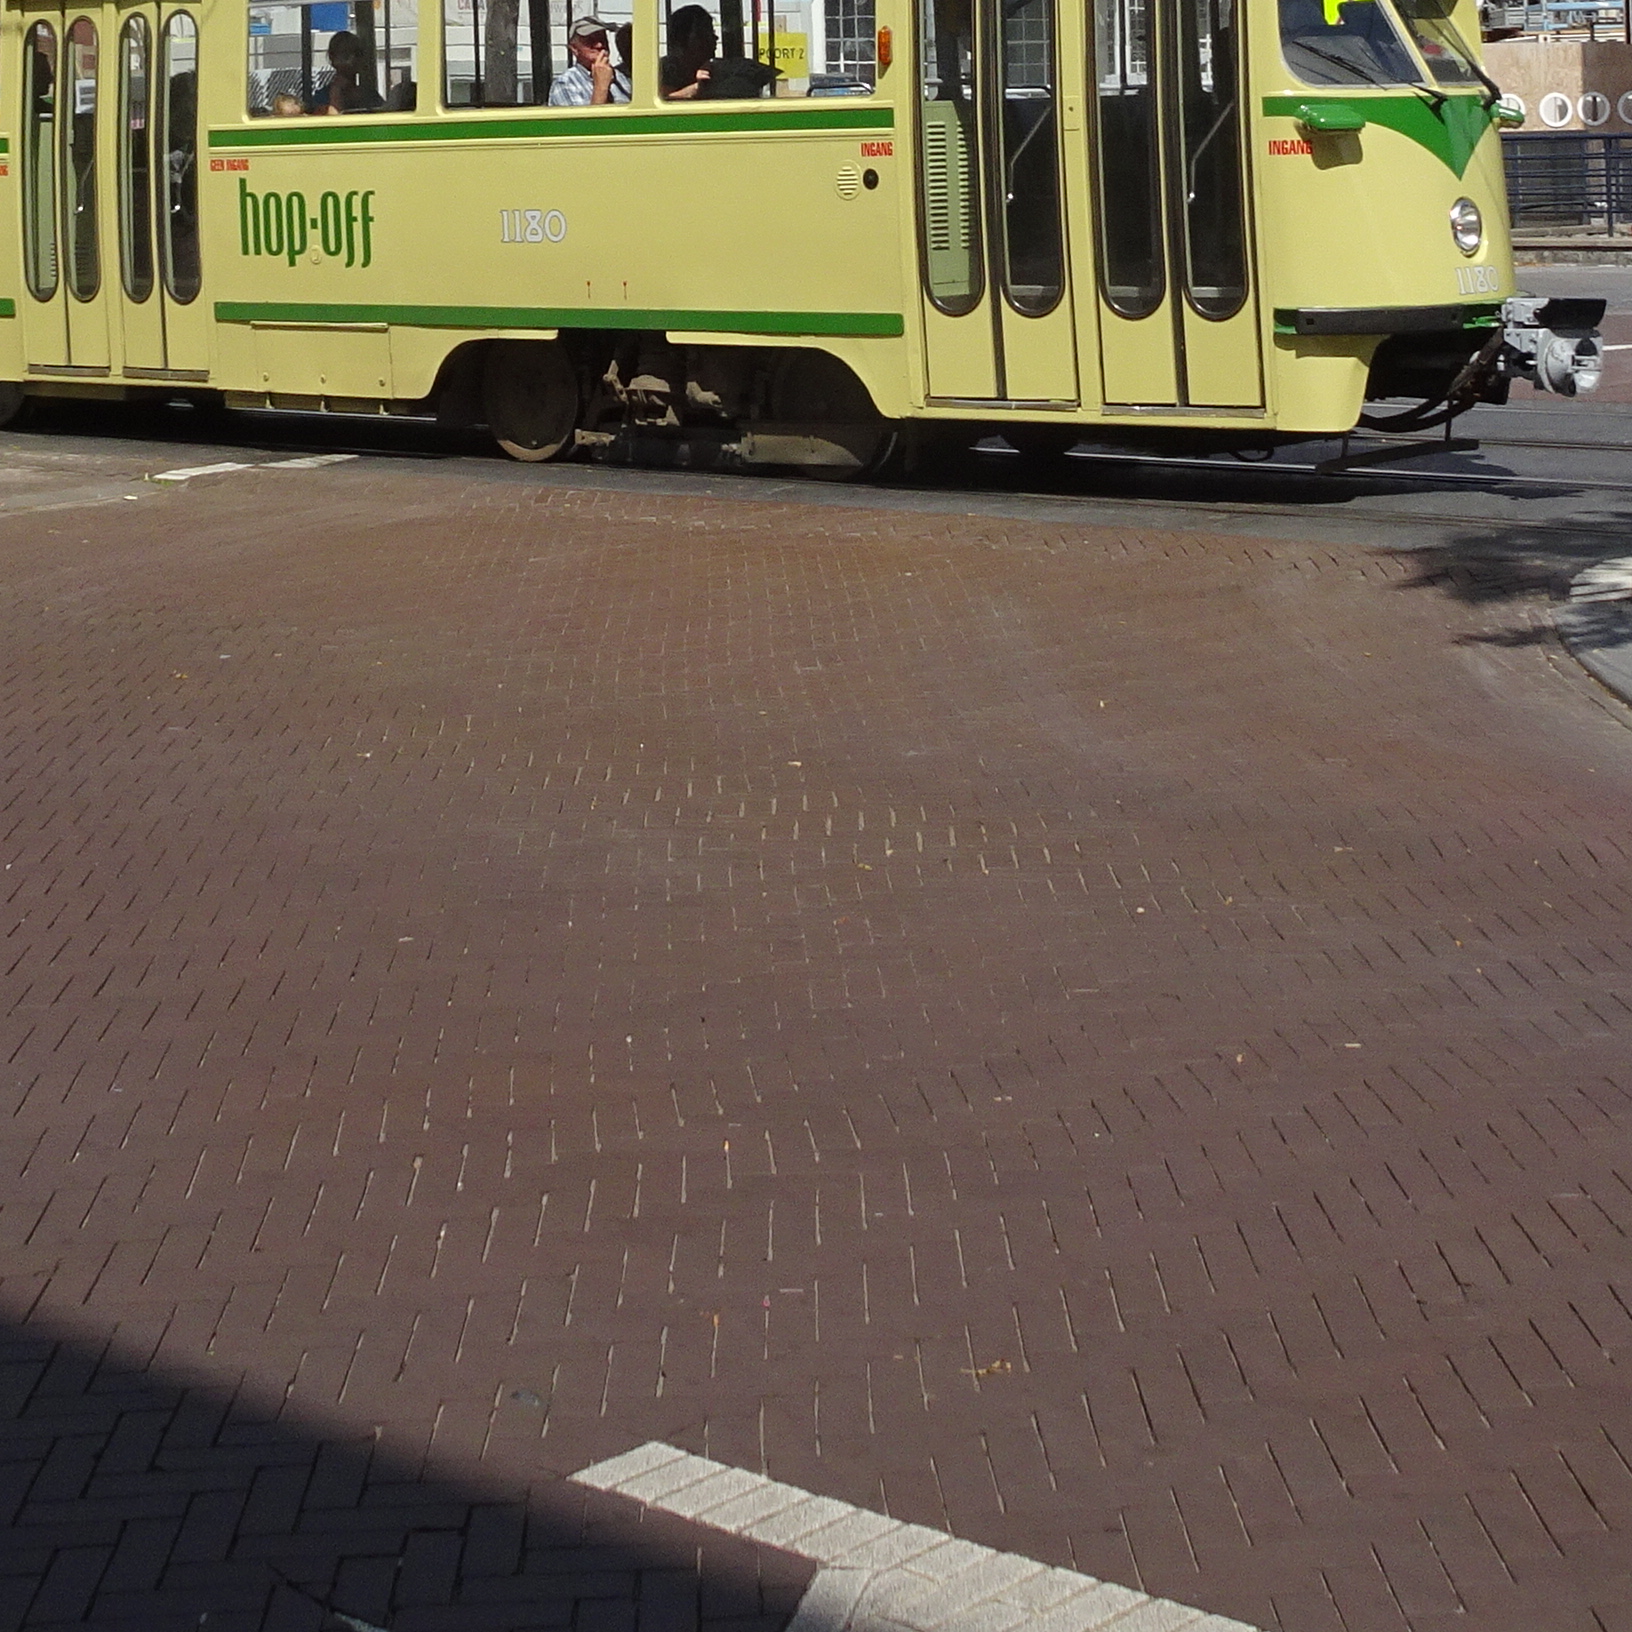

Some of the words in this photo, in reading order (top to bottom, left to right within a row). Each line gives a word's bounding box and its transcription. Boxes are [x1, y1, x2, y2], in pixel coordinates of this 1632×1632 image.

[759, 48, 797, 59] POORT
[798, 49, 805, 59] 2
[861, 142, 893, 157] INGANG
[1269, 140, 1313, 155] INGANG
[211, 159, 224, 171] GEEN
[227, 159, 249, 171] INGANG
[500, 209, 567, 243] 1180
[1456, 265, 1498, 295] 1180
